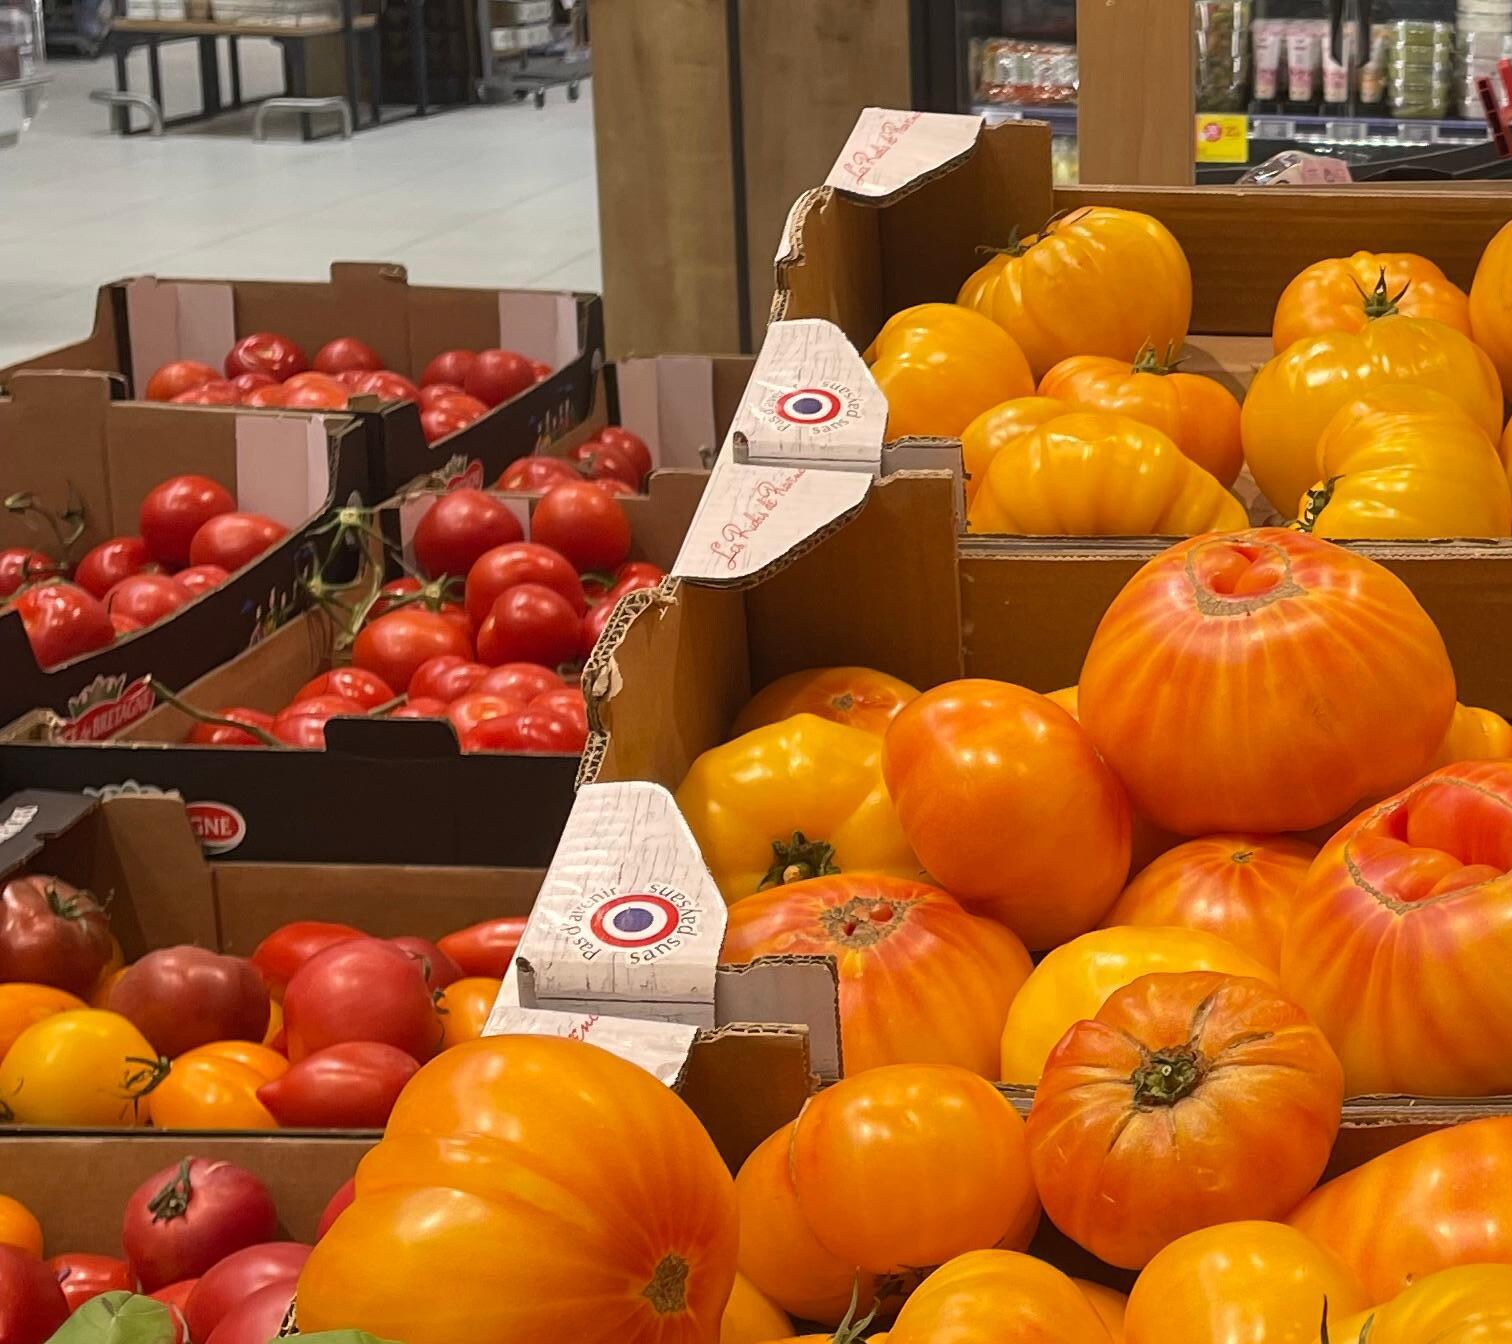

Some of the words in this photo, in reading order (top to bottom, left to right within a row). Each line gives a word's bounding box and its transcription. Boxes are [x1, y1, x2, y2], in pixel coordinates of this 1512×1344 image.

[822, 380, 864, 419] paysans
[812, 418, 850, 435] sans
[648, 882, 703, 937] paysans
[573, 931, 603, 961] Pas
[629, 937, 682, 965] sans
